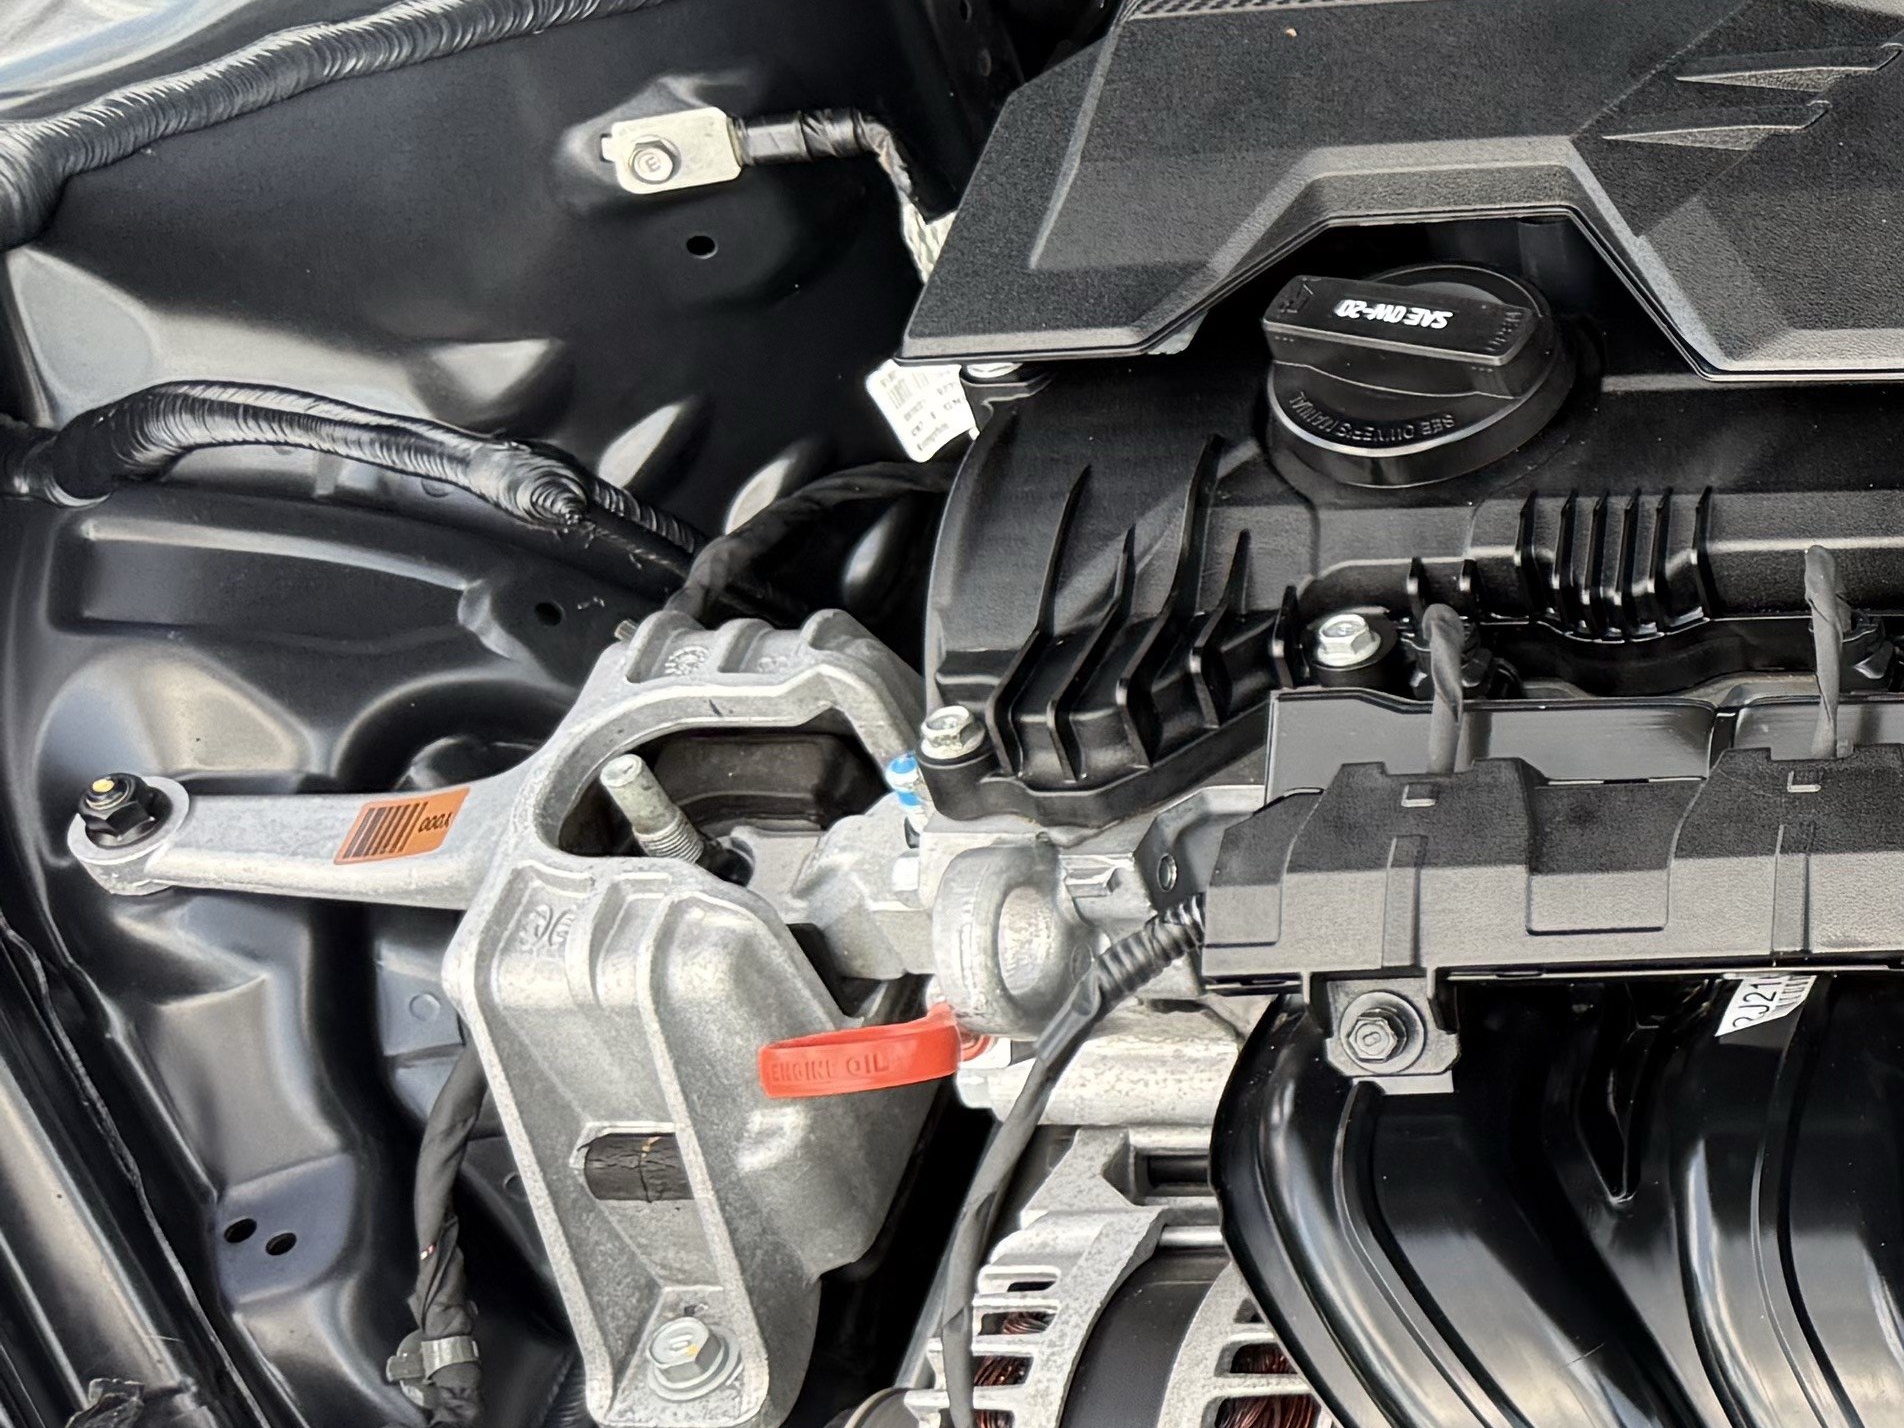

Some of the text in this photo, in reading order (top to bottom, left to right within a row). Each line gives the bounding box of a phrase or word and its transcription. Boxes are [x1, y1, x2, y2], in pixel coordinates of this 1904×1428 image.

[1333, 299, 1454, 329] SAE 0W-20
[1421, 414, 1455, 436] SEE
[770, 1052, 890, 1083] ENGINE OIL
